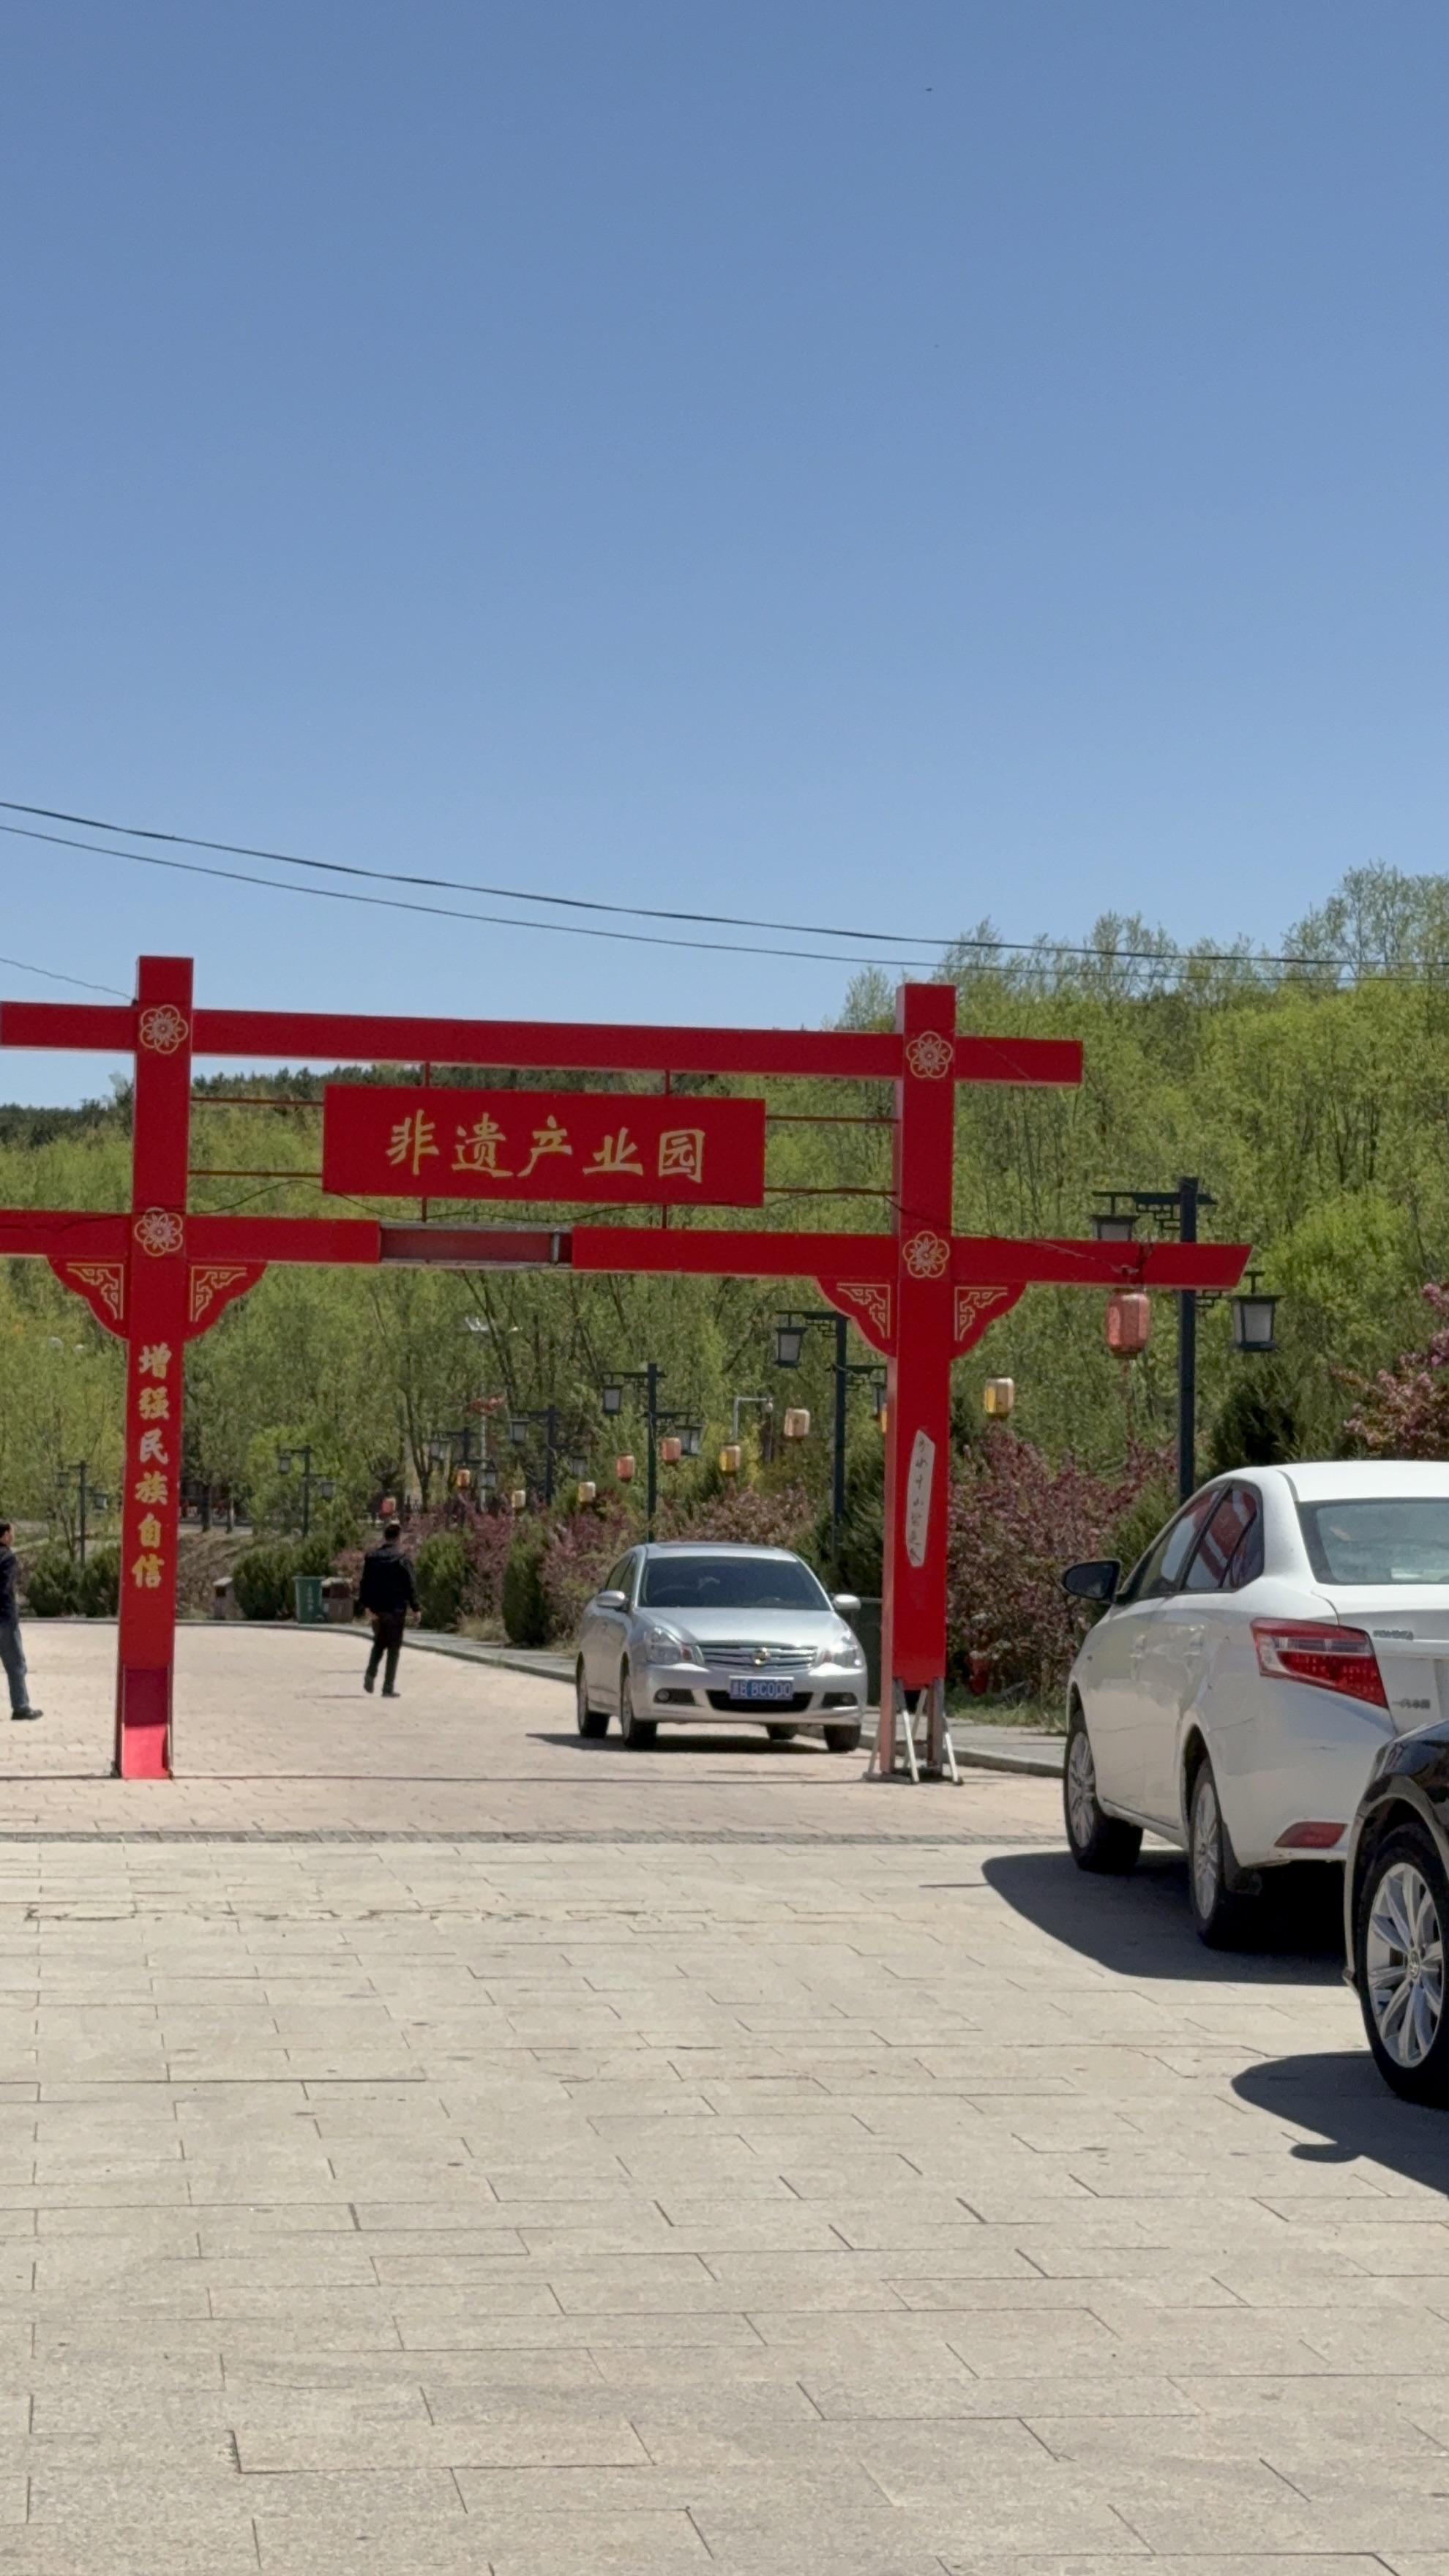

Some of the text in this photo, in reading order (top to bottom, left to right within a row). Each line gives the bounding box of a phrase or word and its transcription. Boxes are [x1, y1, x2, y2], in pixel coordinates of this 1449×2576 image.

[386, 1109, 705, 1183] 非遗产业园
[132, 1342, 172, 1588] 增强民族自信
